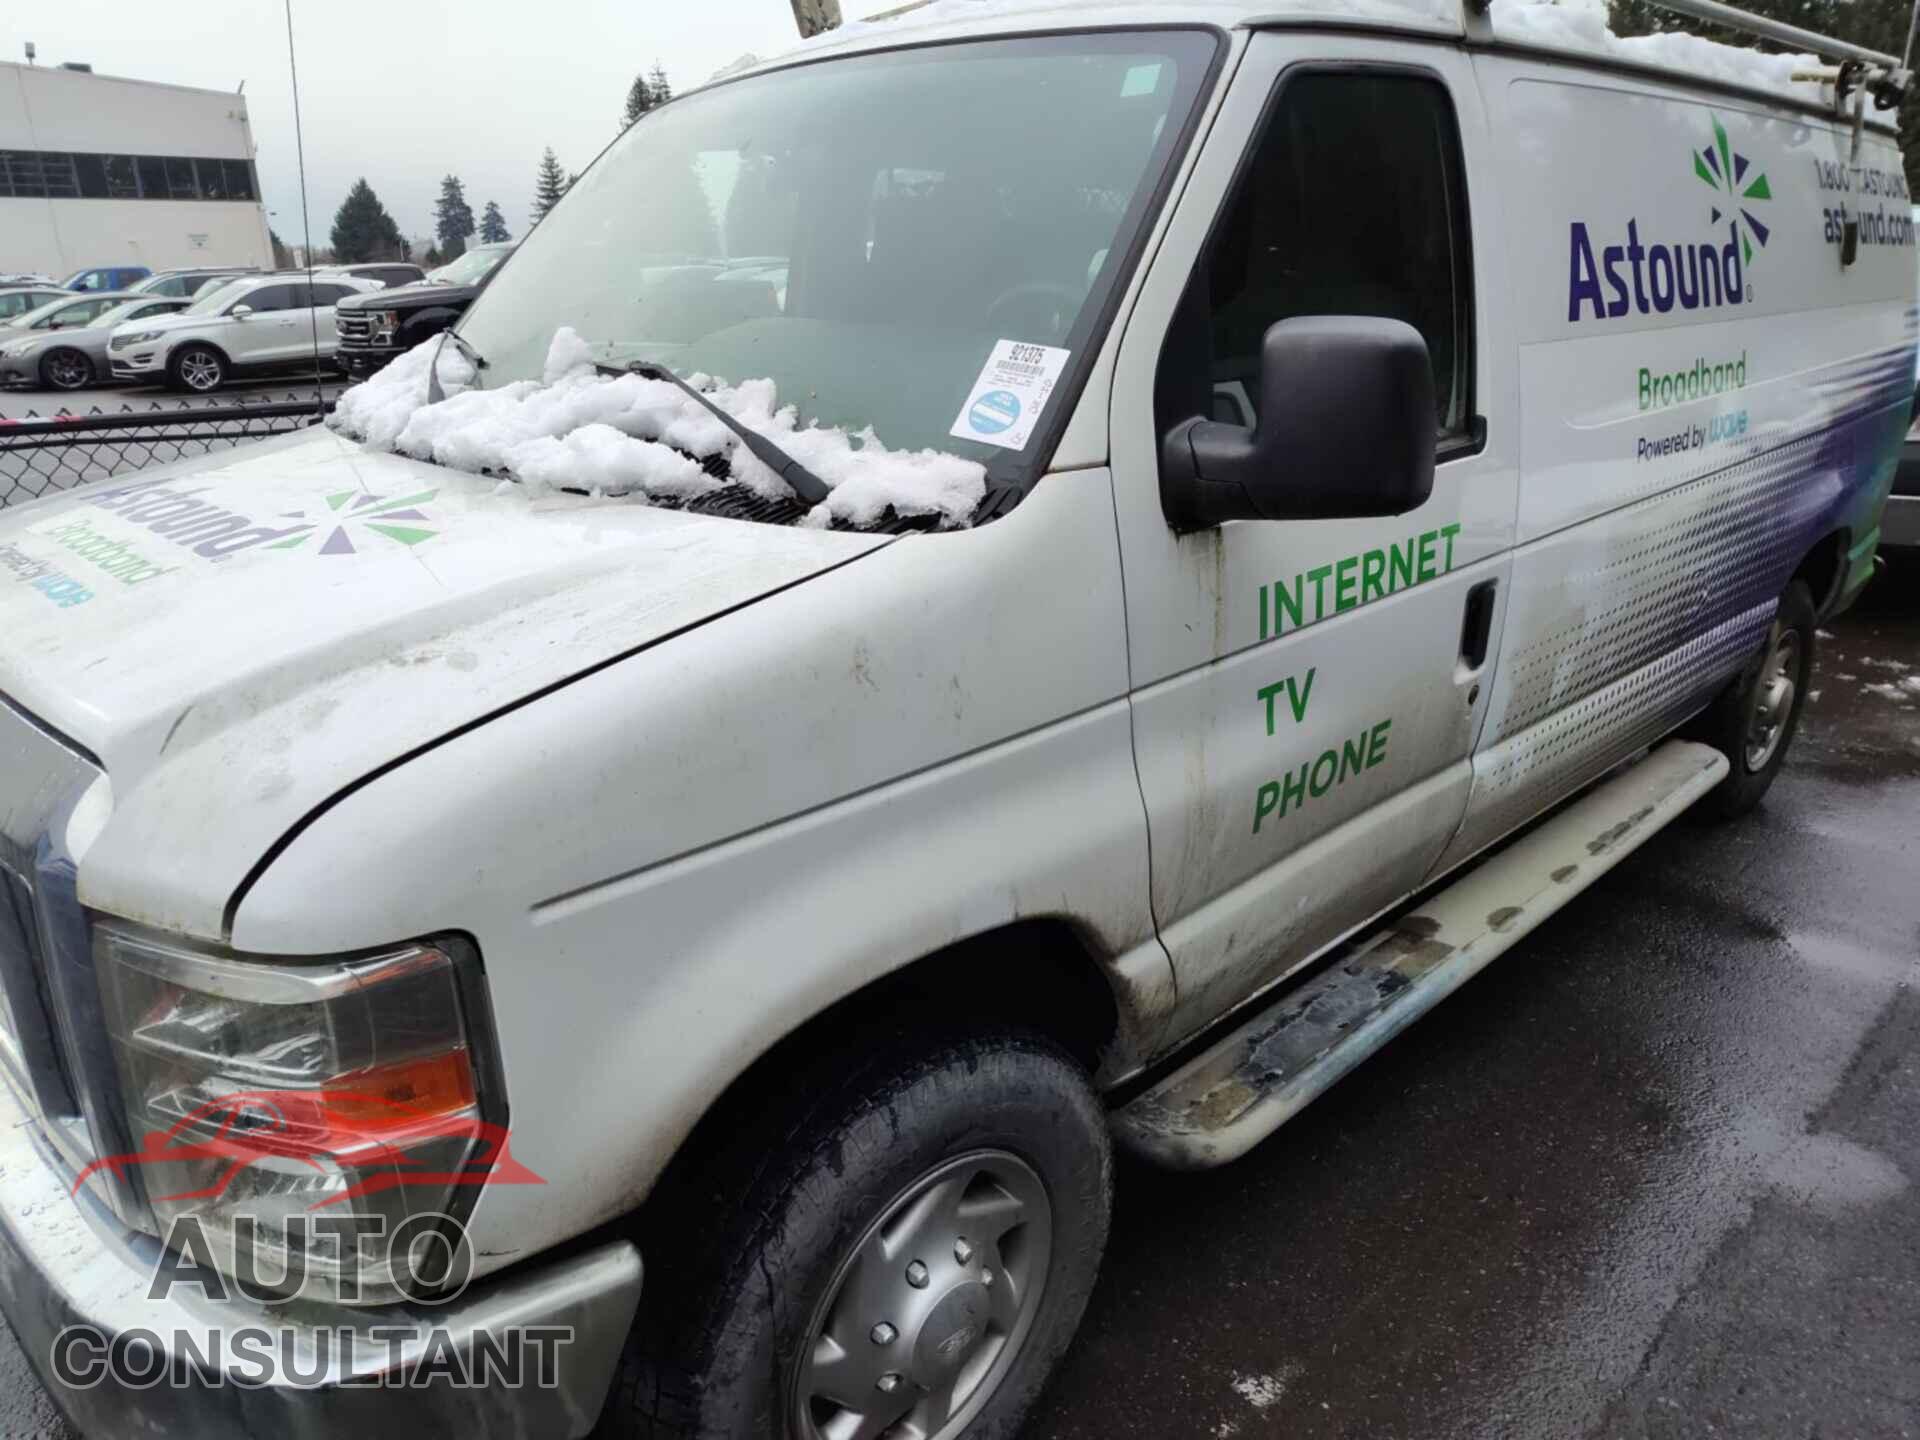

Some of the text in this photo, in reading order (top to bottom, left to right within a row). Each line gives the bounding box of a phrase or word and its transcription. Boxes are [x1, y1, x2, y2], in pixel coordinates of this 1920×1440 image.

[1823, 200, 1916, 246] astund.com
[1568, 216, 1743, 322] Astound
[1638, 350, 1746, 411] Broadband
[1637, 424, 1690, 462] Powered
[1692, 424, 1706, 451] by
[44, 519, 182, 585] Broadband
[80, 478, 318, 557] Astound
[1259, 523, 1461, 640] INTERNET
[1257, 667, 1316, 736] TV
[1252, 718, 1392, 834] PHONE
